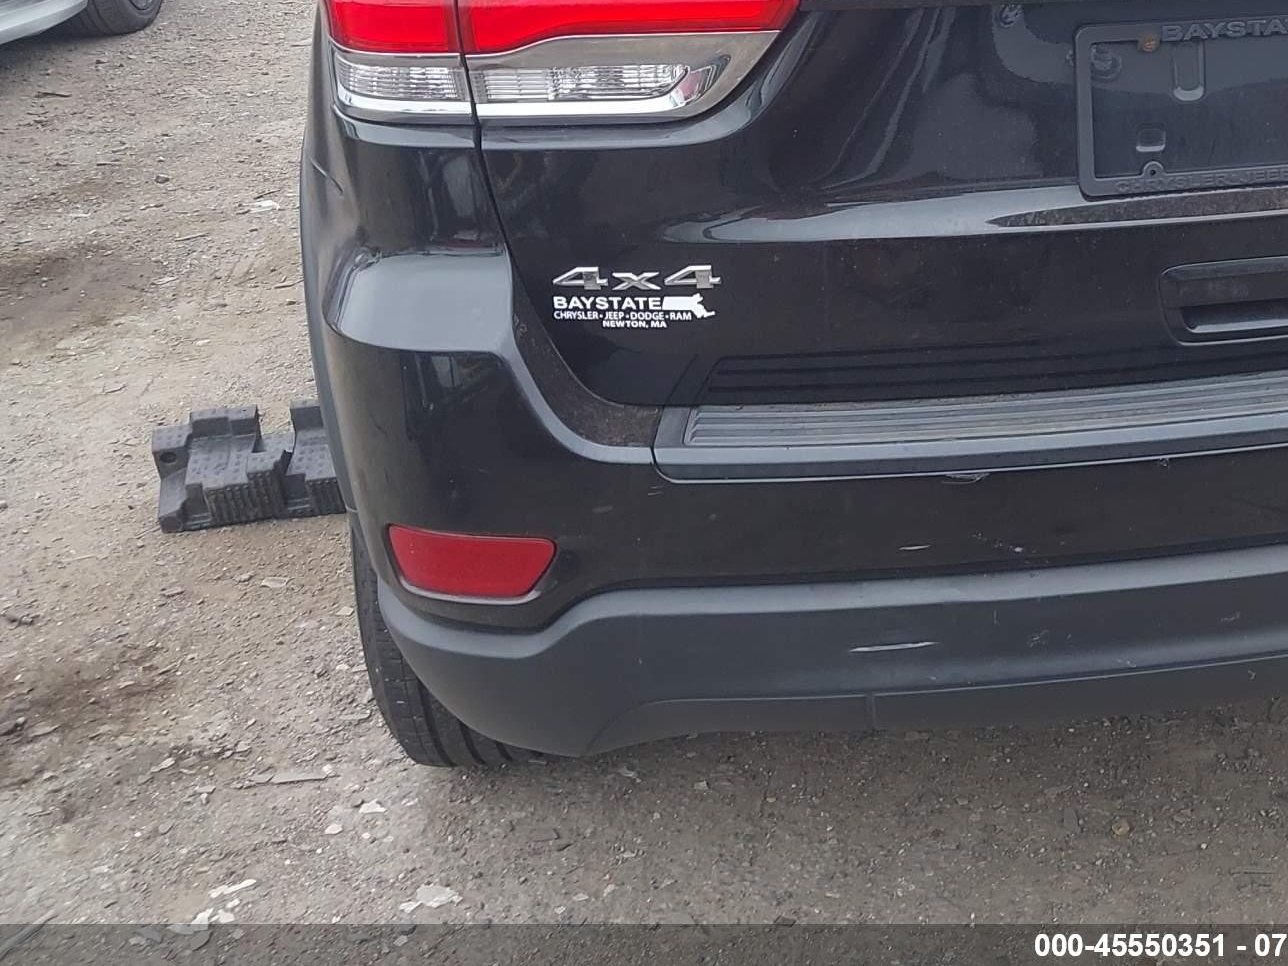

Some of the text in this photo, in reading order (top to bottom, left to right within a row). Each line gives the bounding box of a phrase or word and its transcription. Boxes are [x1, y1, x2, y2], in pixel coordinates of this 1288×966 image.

[552, 264, 722, 291] 4x4
[553, 296, 662, 310] BAYSTATE
[602, 320, 667, 329] NEWTON, MA
